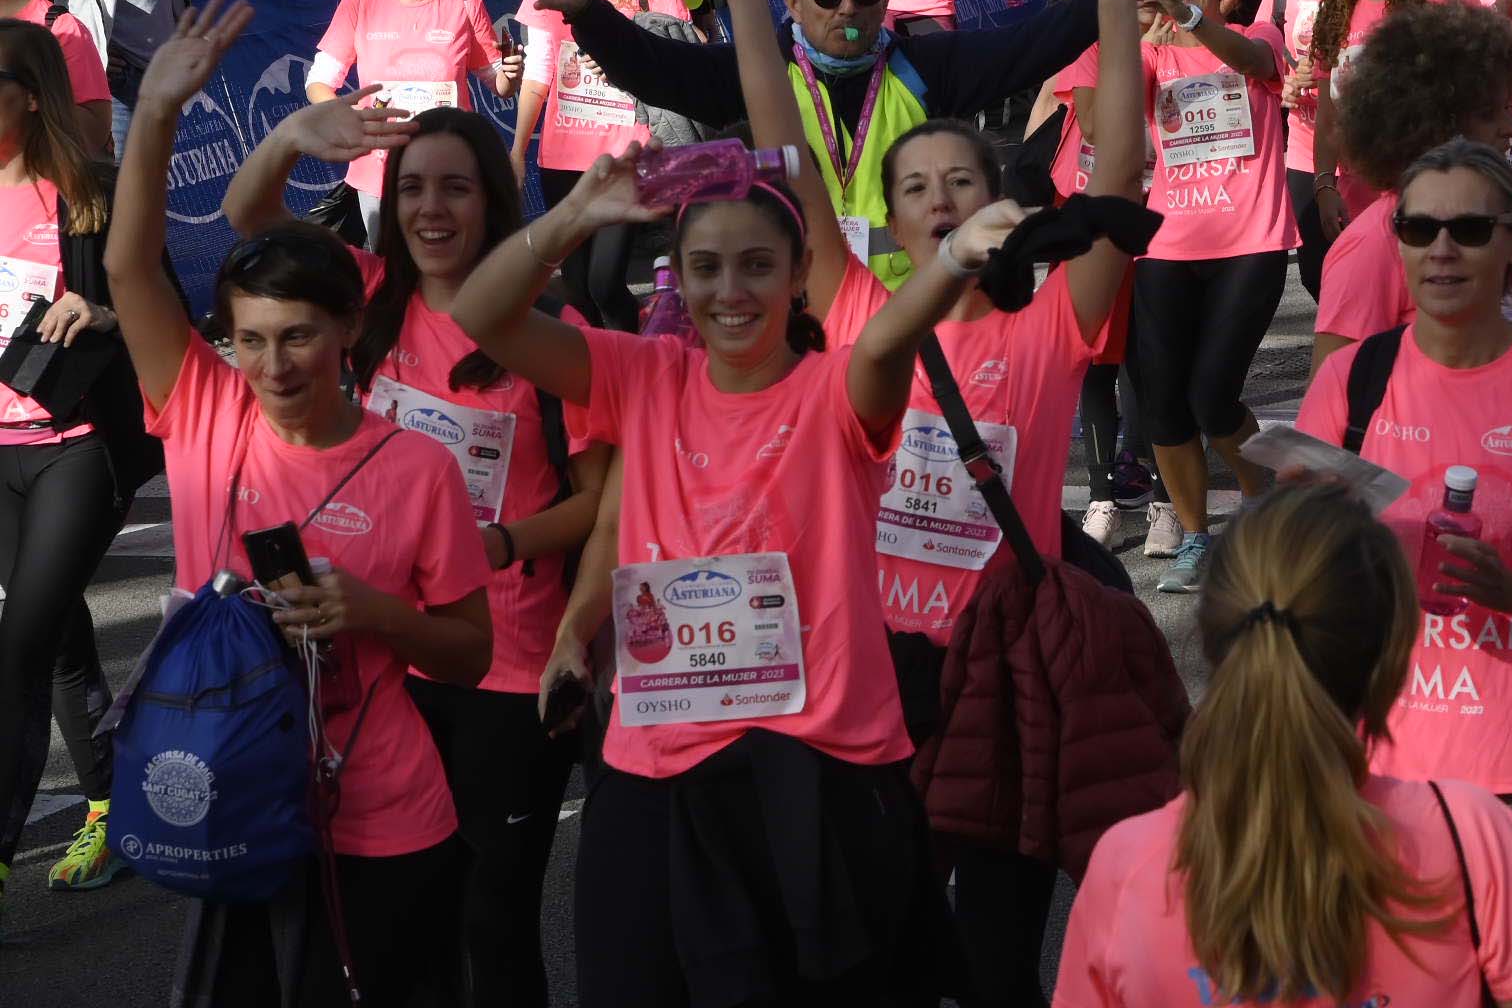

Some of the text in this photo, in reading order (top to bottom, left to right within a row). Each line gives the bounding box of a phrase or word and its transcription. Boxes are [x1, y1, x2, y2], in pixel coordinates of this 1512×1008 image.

[1184, 107, 1217, 123] 016
[1189, 123, 1215, 134] 12595
[1165, 157, 1250, 184] DORSAL
[1166, 183, 1232, 209] SUMA
[408, 414, 460, 441] ASTURIANA
[471, 428, 503, 440] SUMA
[900, 468, 953, 495] 016
[904, 496, 938, 514] 5841
[878, 510, 987, 538] RERA DE LA MUJER 2023
[936, 542, 986, 559] Santander
[747, 574, 782, 585] SUMA
[670, 586, 737, 601] ASTURIANA
[677, 620, 736, 647] 016
[689, 651, 726, 668] 5840
[640, 669, 785, 688] CARRERA DE LA MUJER 2023
[1411, 662, 1480, 701] MA
[637, 698, 691, 714] OYSHO
[735, 692, 791, 706] Santander
[1459, 705, 1485, 715] 2023
[152, 750, 185, 765] CURSA
[142, 780, 200, 799] SANT CUGAT
[145, 842, 248, 862] APROPERTIES
